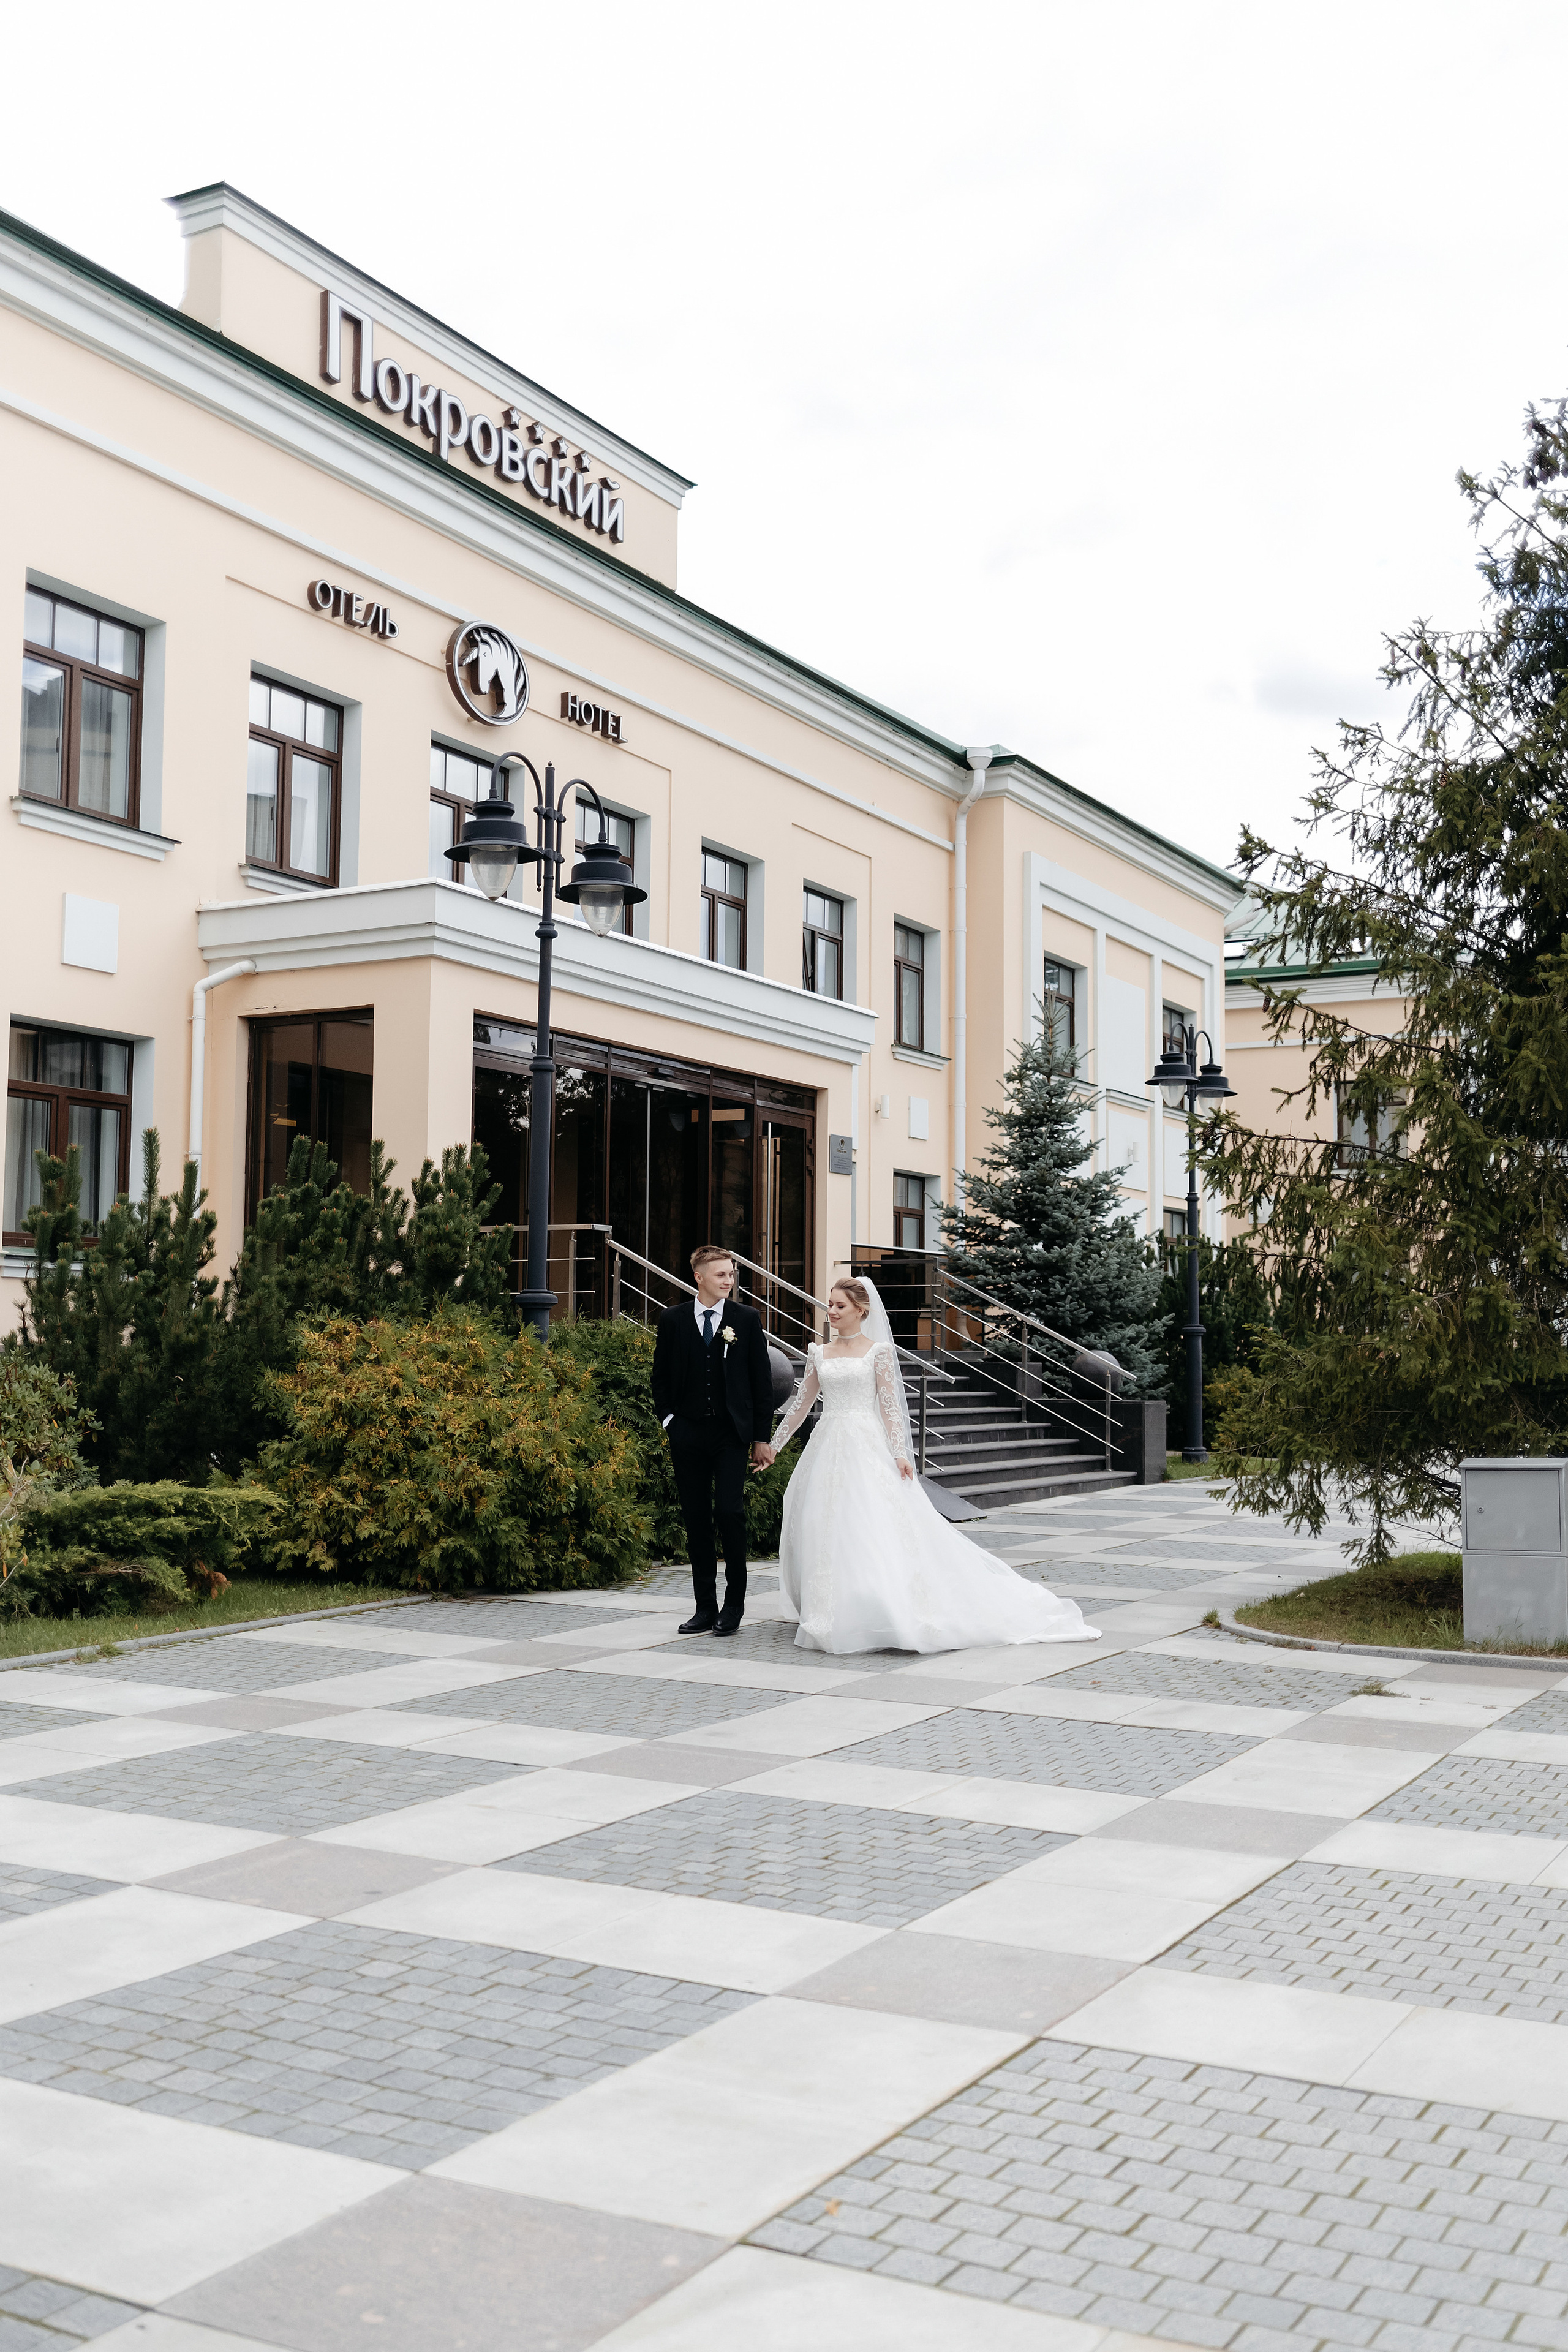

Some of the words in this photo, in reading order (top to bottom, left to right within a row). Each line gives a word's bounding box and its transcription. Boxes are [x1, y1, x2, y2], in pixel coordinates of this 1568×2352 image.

[320, 290, 624, 544] Покровский
[307, 579, 399, 639] ОТЕЛЬ
[560, 691, 628, 744] HOTEL
